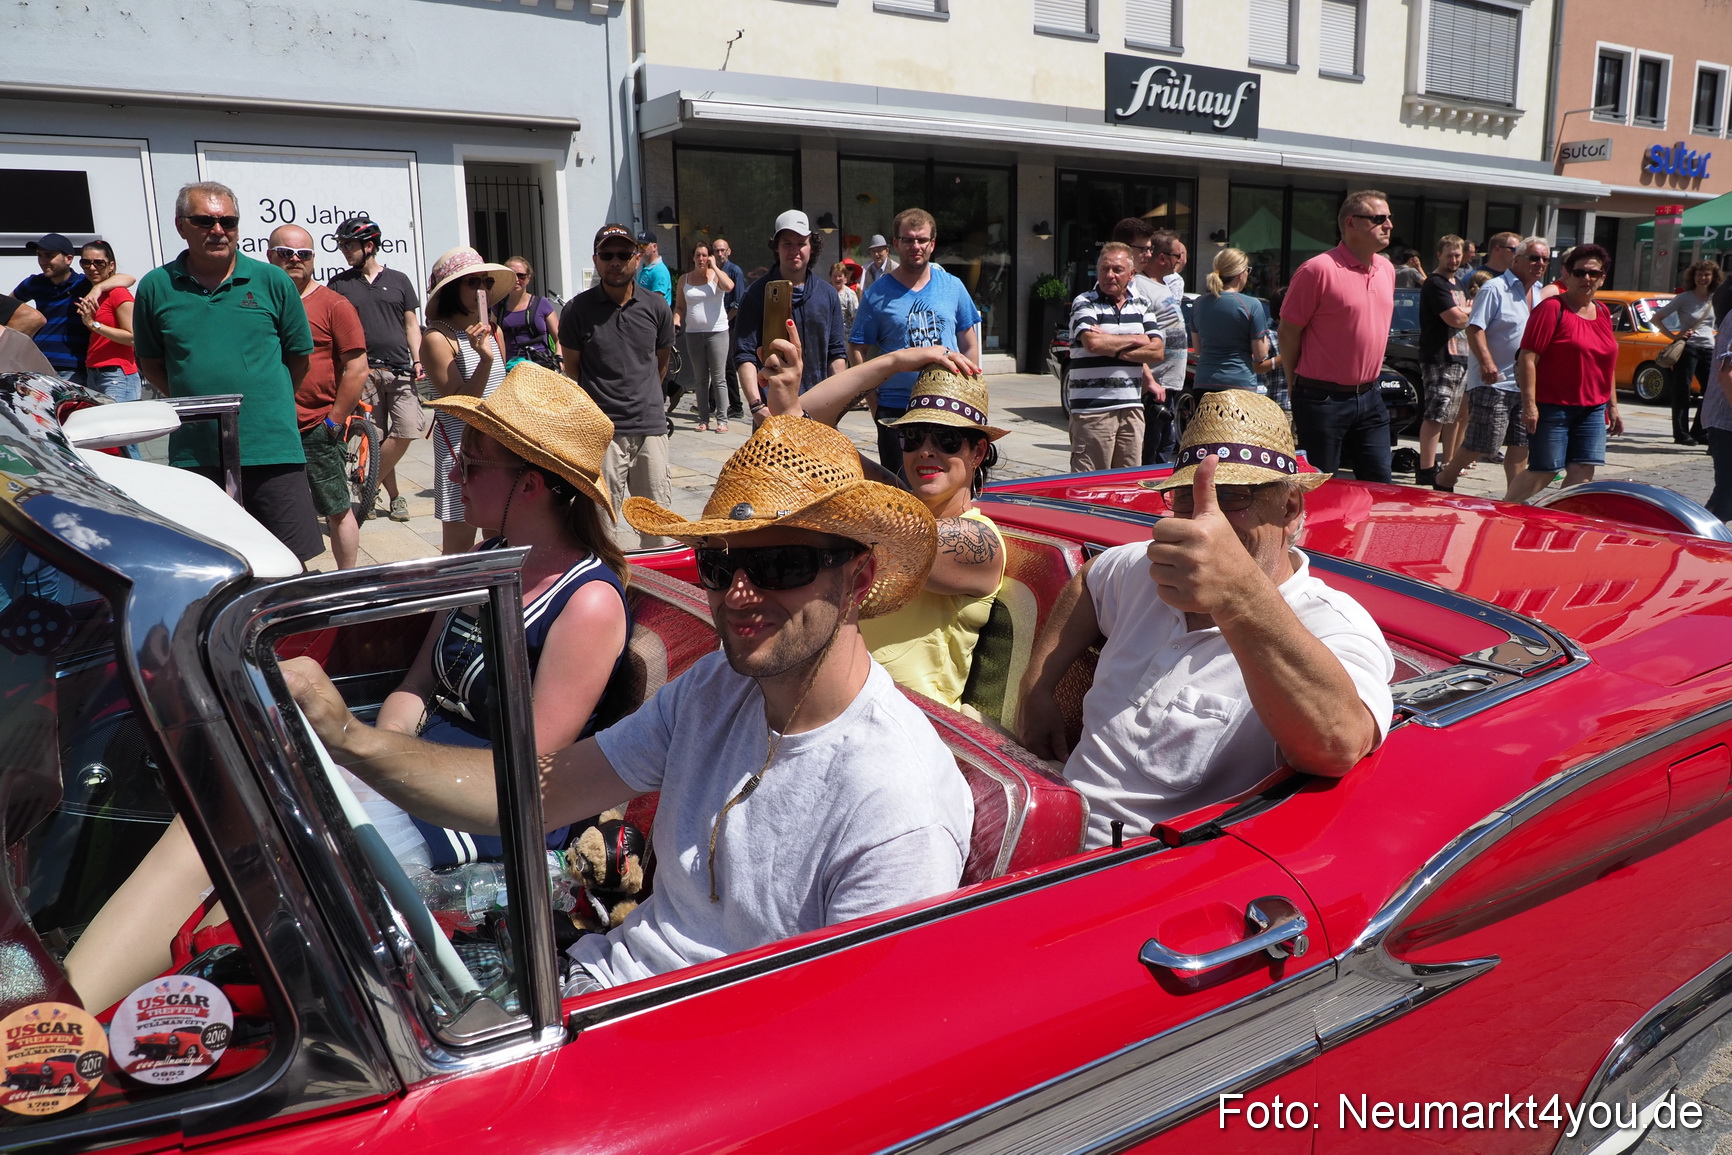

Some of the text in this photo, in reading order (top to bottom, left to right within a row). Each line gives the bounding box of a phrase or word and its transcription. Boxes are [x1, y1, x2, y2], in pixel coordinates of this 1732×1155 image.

[1115, 65, 1257, 128] frühauf
[259, 198, 296, 224] 30
[146, 1006, 201, 1017] TREFFEN
[136, 1019, 184, 1031] PULLMAN
[18, 1035, 74, 1047] TREFFEN
[204, 1028, 227, 1045] 2016
[7, 1047, 56, 1061] PULLMAN
[80, 1056, 103, 1073] 2017
